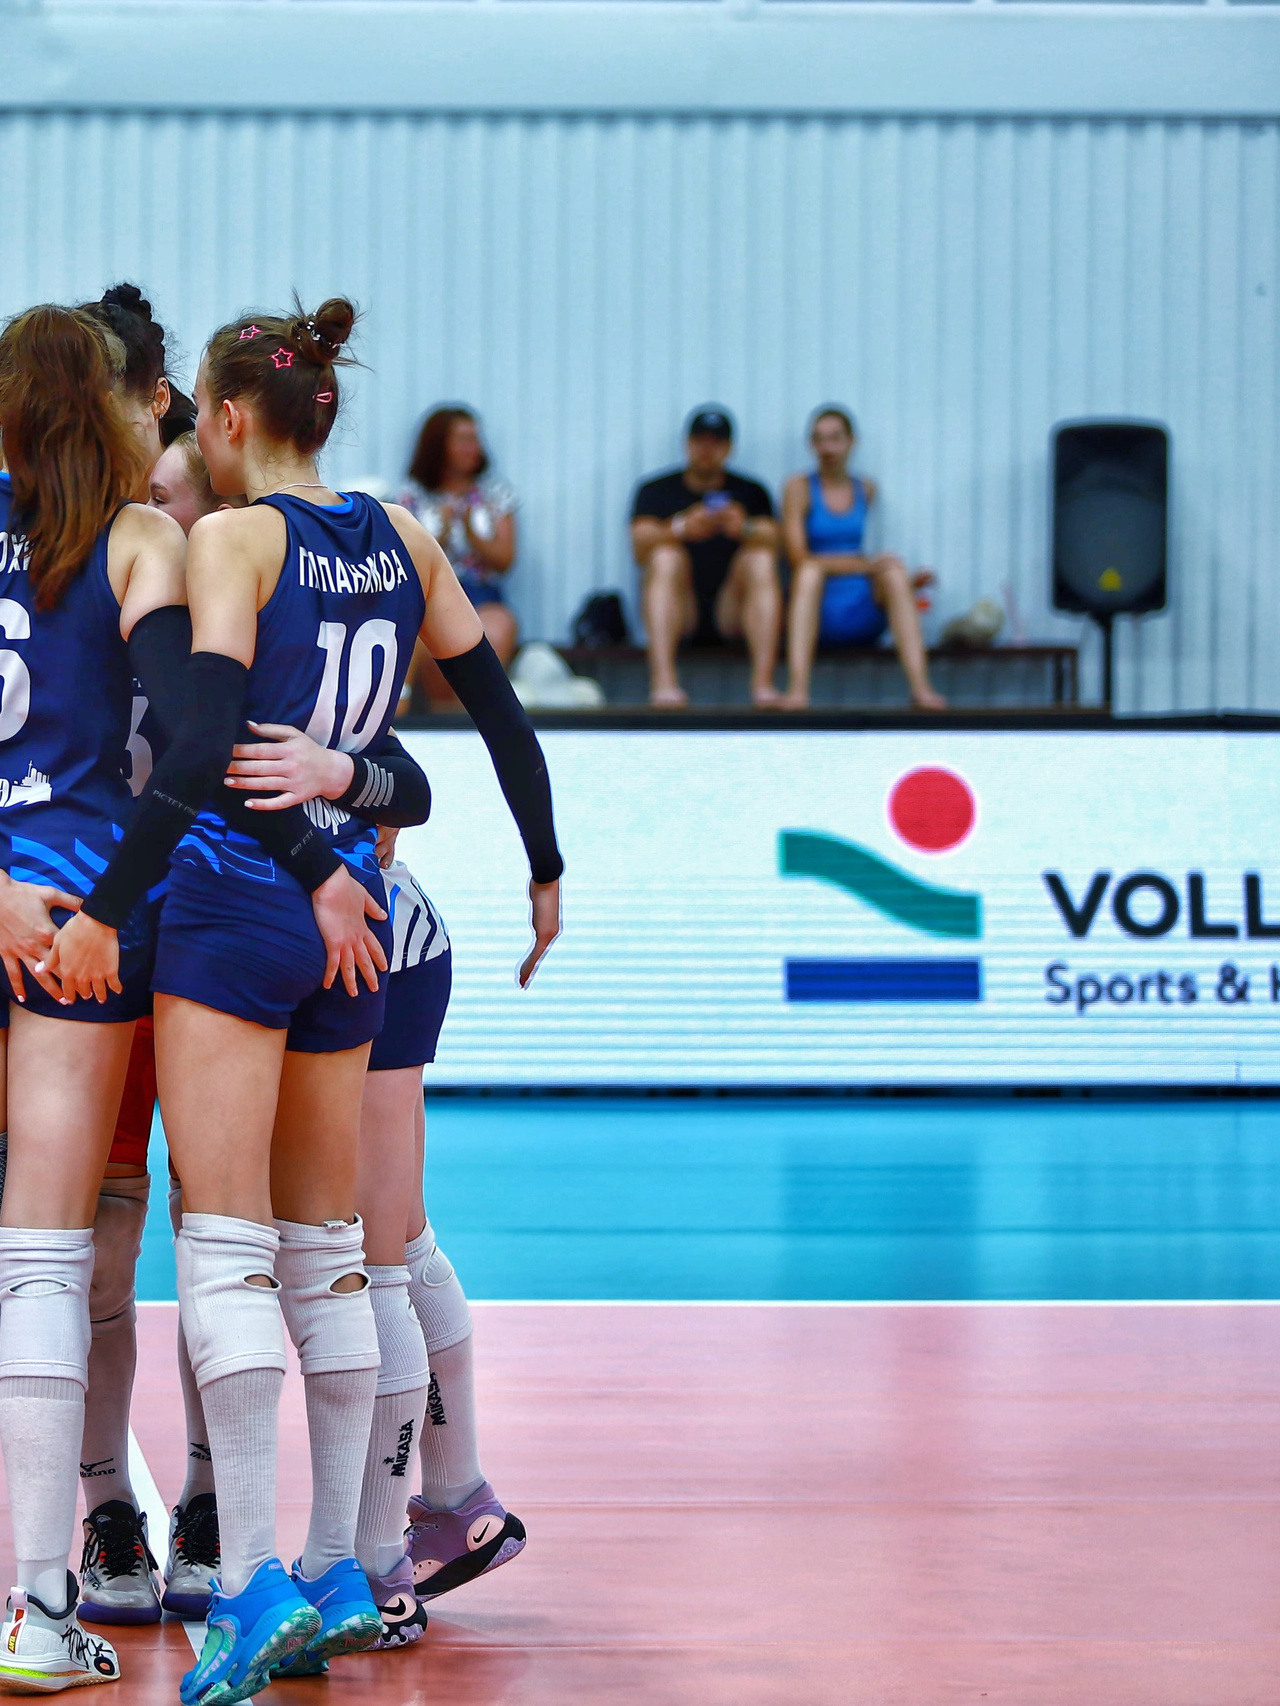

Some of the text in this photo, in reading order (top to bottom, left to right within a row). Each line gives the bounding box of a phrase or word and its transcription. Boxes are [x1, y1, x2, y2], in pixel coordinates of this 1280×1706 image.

[304, 618, 398, 755] 10
[1044, 960, 1197, 1014] Sports
[1216, 961, 1250, 1003] &
[388, 1418, 415, 1477] MIKASA
